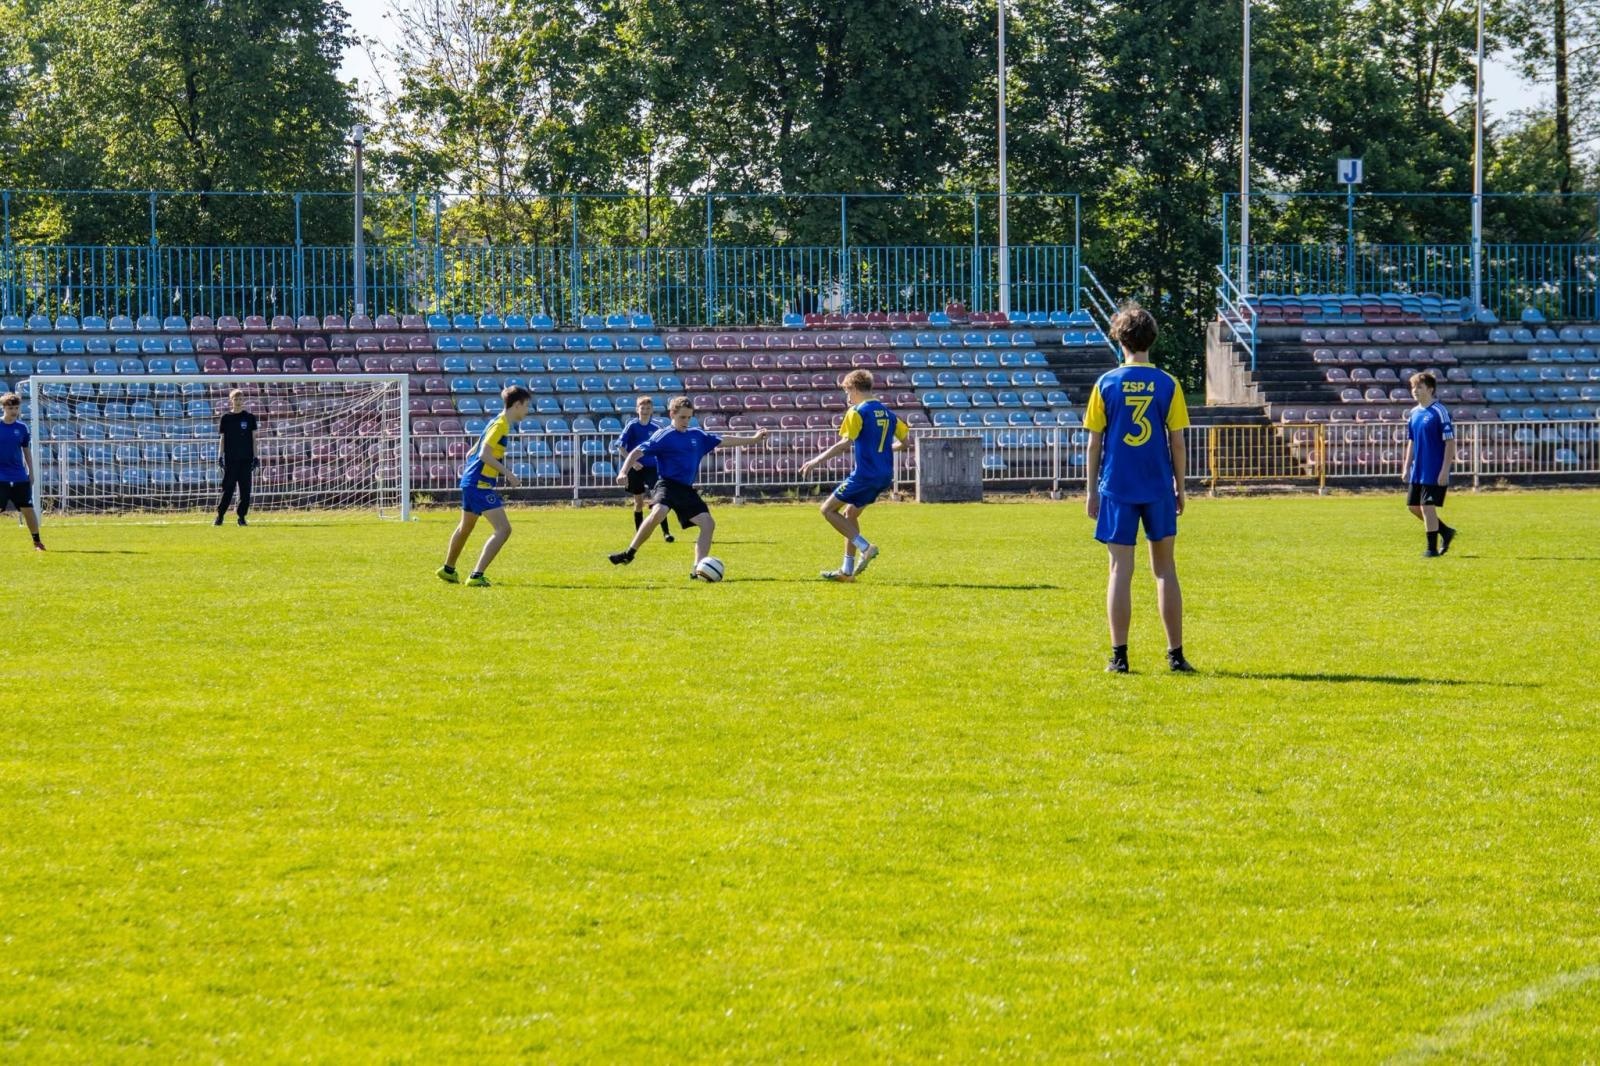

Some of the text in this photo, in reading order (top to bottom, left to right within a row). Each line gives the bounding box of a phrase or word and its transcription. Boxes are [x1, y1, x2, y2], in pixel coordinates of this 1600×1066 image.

[1343, 161, 1357, 182] J
[1122, 381, 1155, 392] ZSP 4
[1123, 395, 1154, 446] 3
[877, 418, 890, 453] 7
